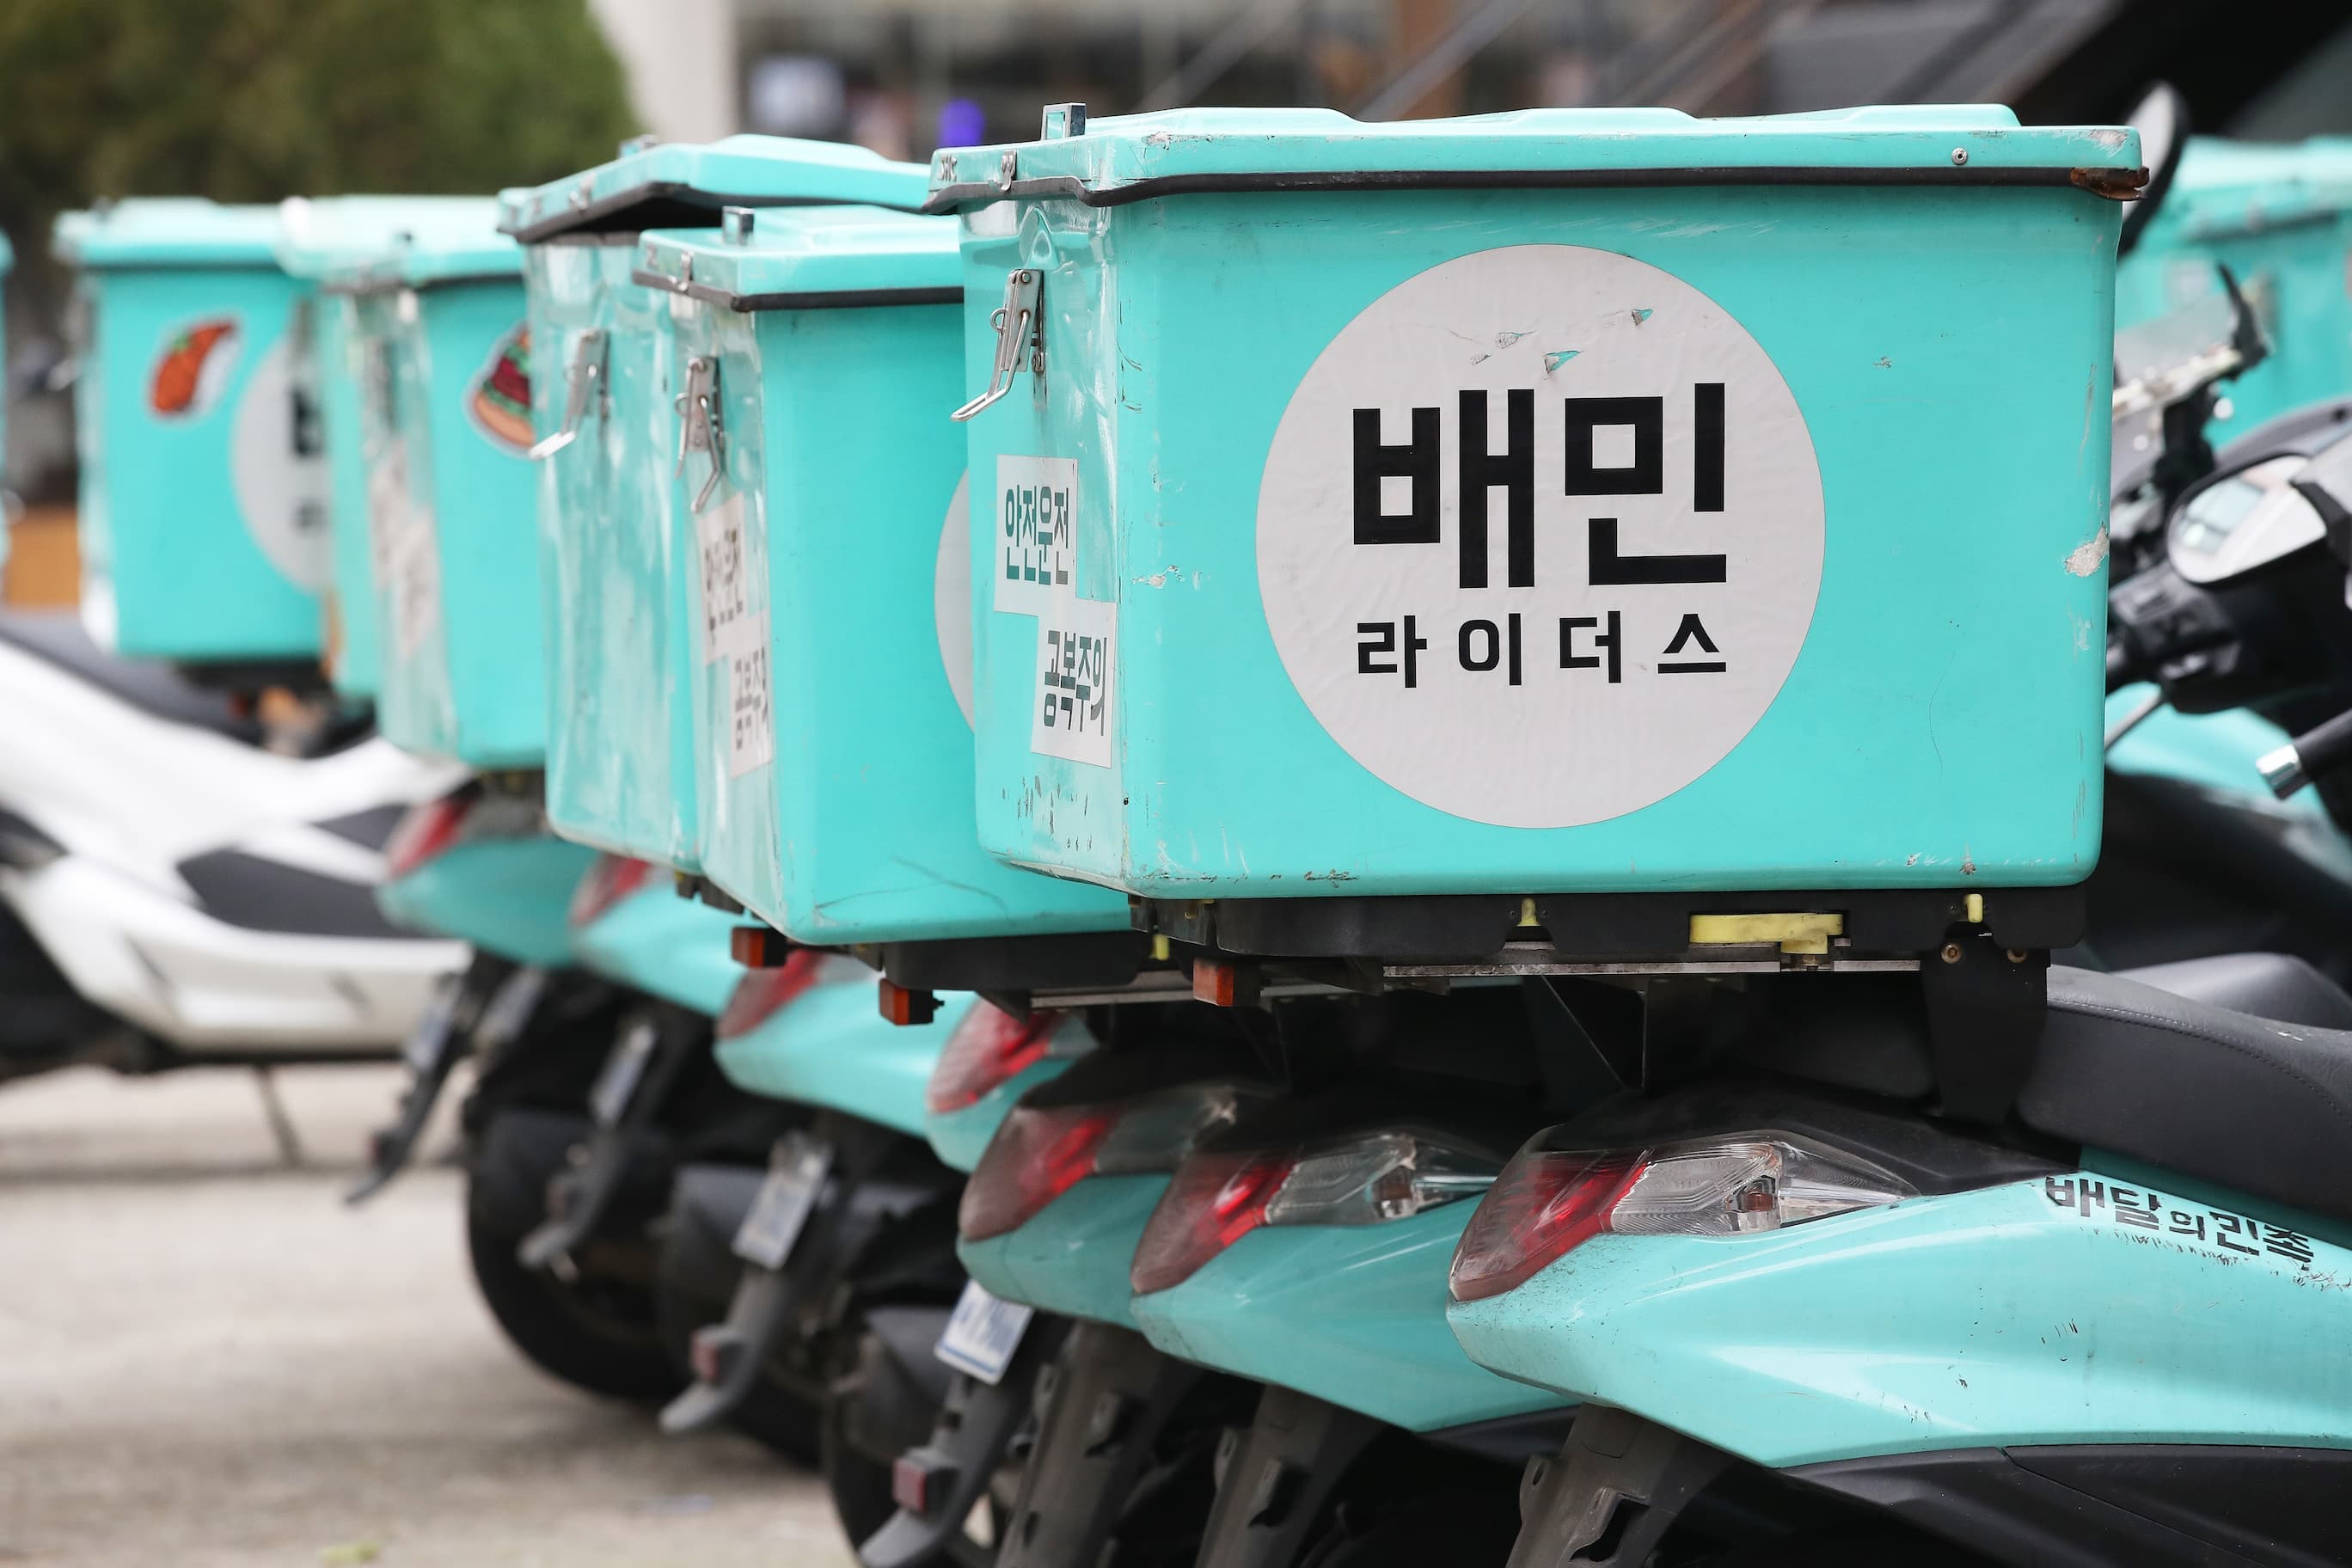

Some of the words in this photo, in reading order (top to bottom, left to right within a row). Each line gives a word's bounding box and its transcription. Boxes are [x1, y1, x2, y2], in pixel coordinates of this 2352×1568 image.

[1005, 484, 1069, 585] 안전운전
[1353, 383, 1726, 588] 배민
[1044, 630, 1107, 736] 공복주의
[1357, 610, 1726, 688] 라이더스
